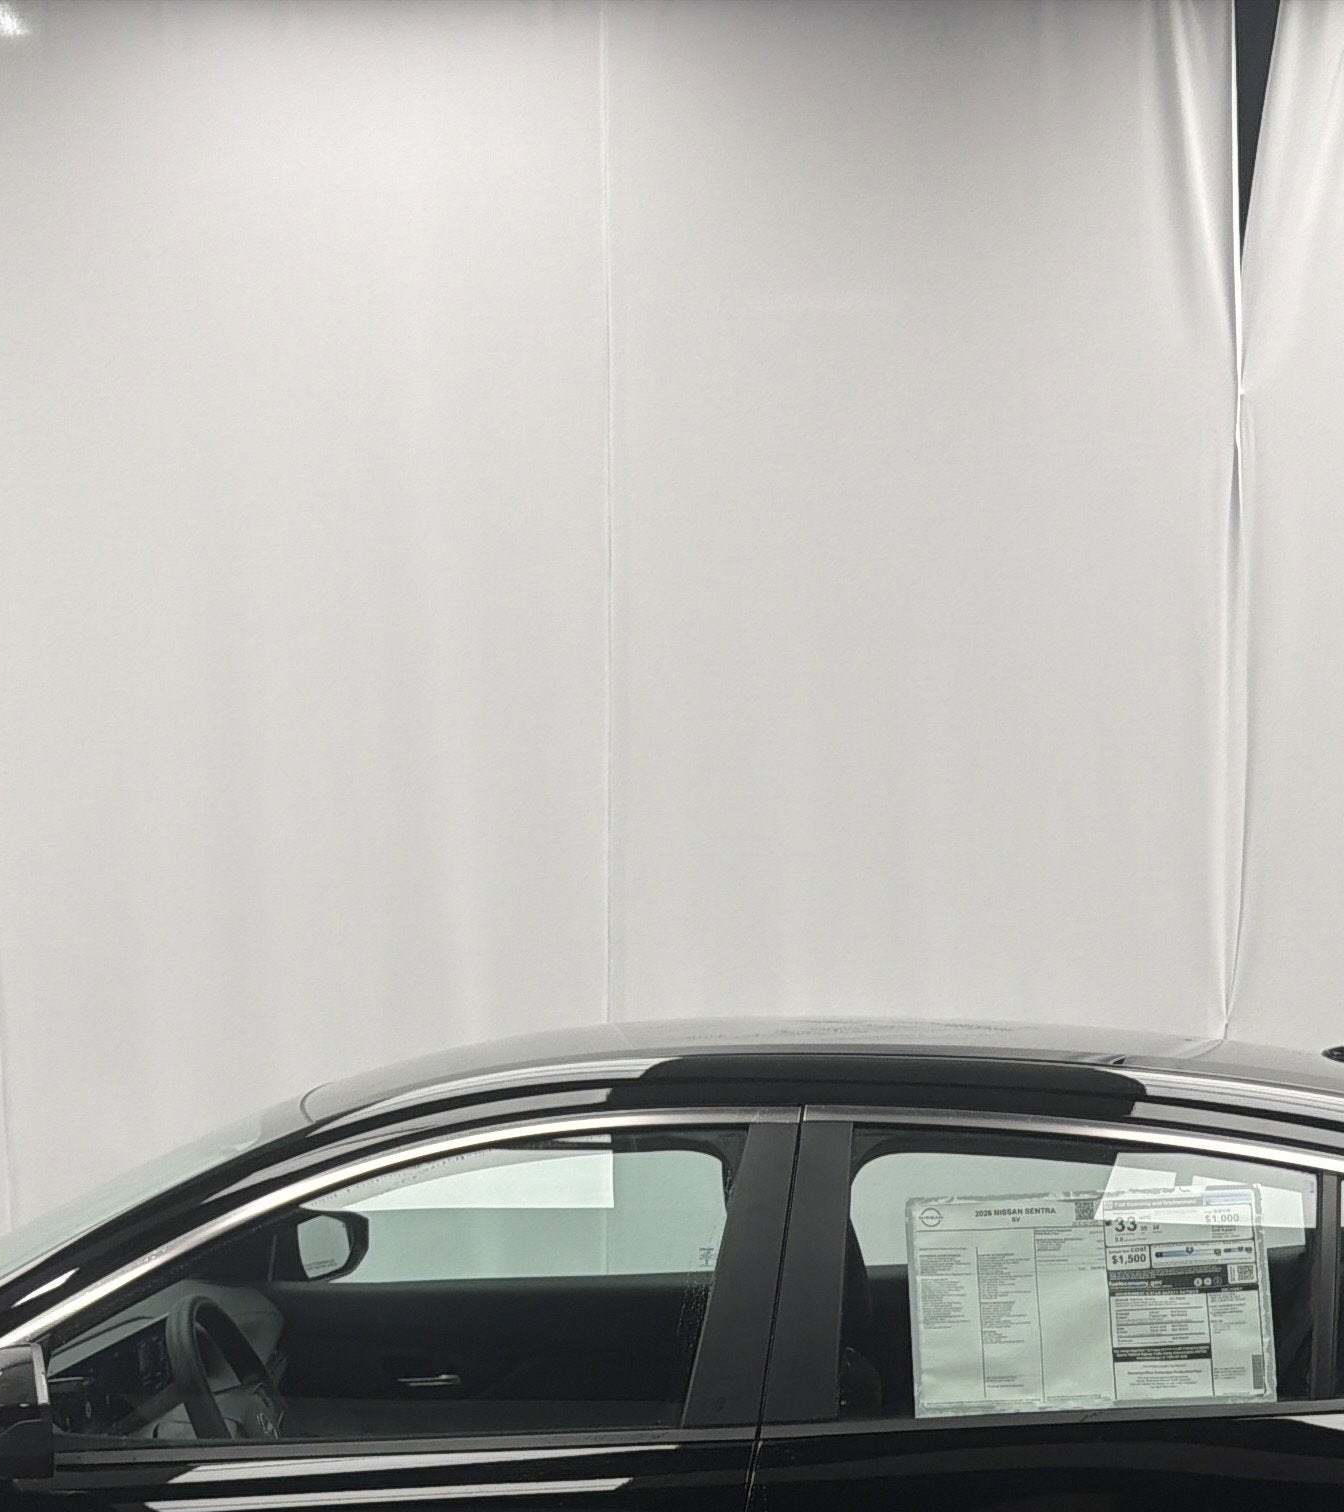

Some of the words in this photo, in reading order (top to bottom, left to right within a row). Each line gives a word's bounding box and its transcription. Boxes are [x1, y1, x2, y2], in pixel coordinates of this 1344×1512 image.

[975, 1209, 992, 1217] 2026
[993, 1208, 1023, 1216] NISSAN
[1024, 1207, 1056, 1215] SENTRA
[1204, 1213, 1239, 1223] $1,000
[1115, 1216, 1137, 1232] 33
[1111, 1253, 1146, 1265] $1,500
